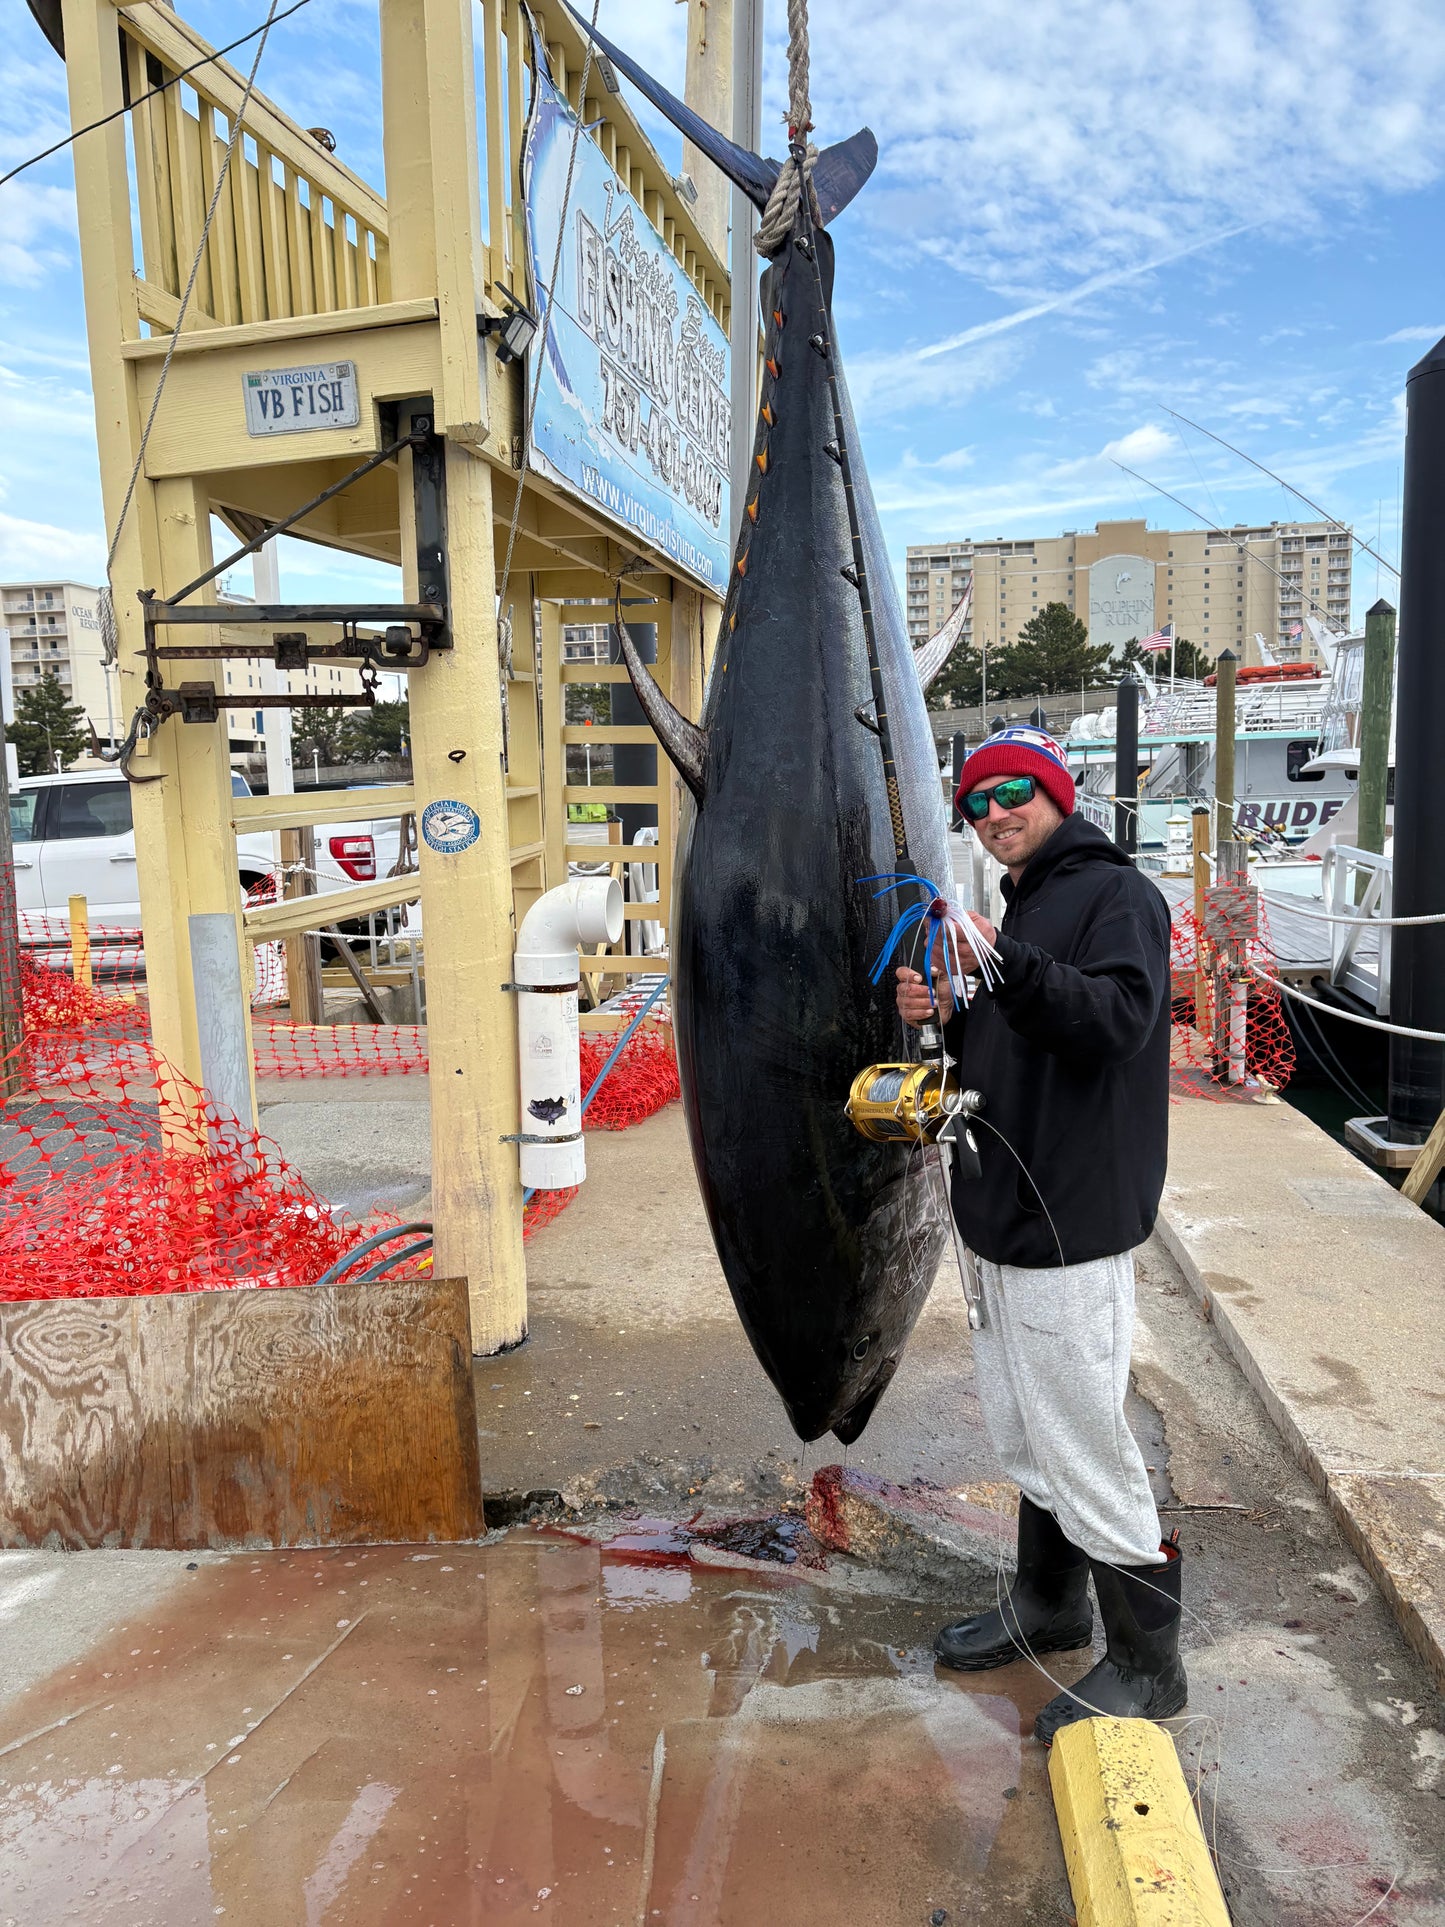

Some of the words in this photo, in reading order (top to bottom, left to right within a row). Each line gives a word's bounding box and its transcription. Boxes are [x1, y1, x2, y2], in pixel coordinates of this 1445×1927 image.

[576, 209, 674, 408] FISHING
[272, 371, 326, 385] VIRGINIA
[257, 389, 285, 419] VB
[290, 381, 344, 416] FISH
[581, 461, 713, 579] www.virginiafishing.com
[72, 606, 93, 619] OCEAN
[1090, 600, 1153, 615] DOLPHIN
[1105, 613, 1140, 626] RUN
[424, 801, 453, 818] OFFICIAL
[1236, 801, 1344, 828] RUDE
[448, 834, 477, 852] STATION
